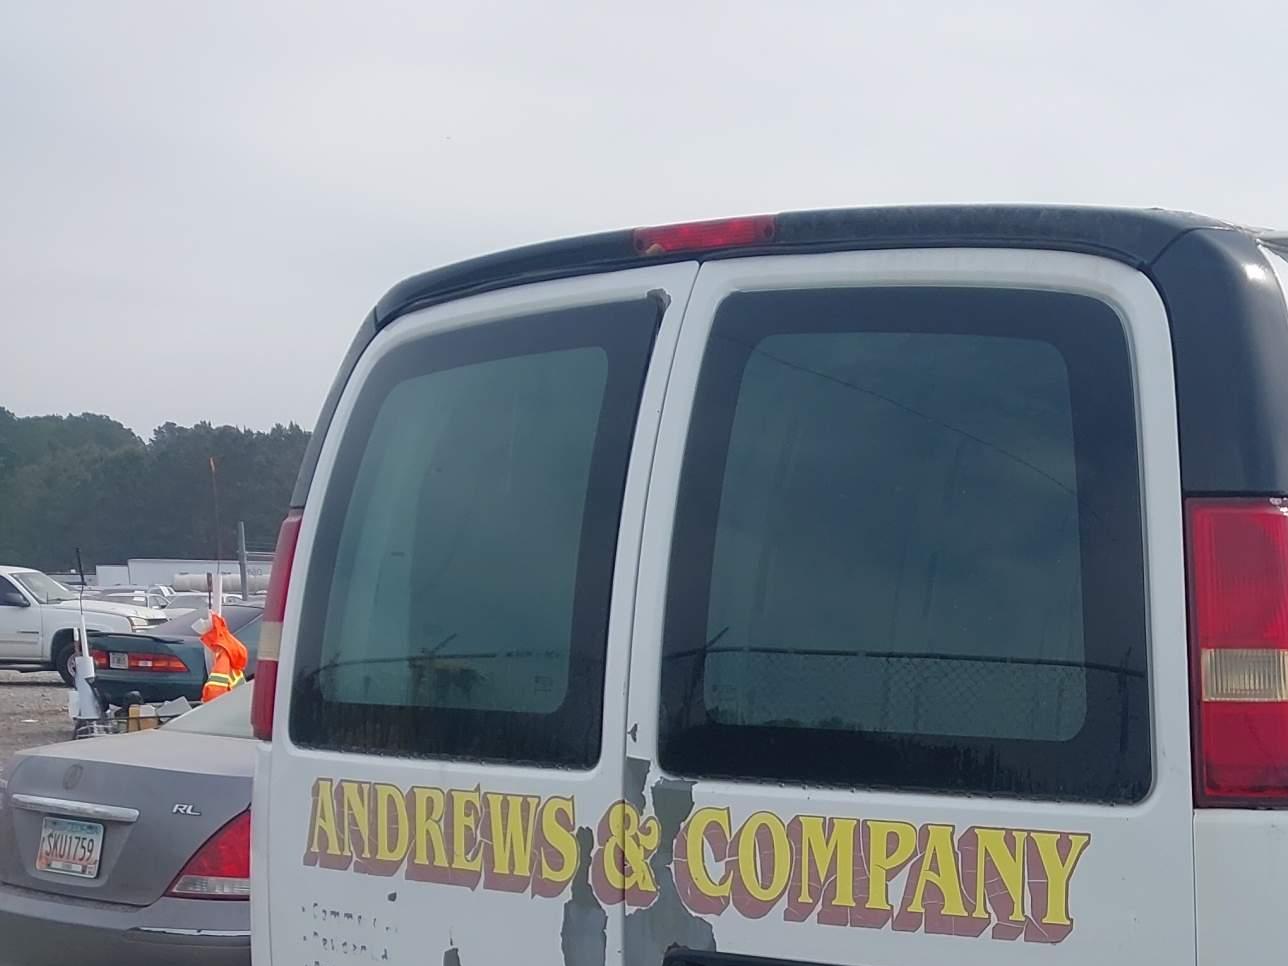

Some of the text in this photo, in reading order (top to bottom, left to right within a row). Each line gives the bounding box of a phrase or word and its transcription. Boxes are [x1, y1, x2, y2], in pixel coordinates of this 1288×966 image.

[172, 803, 201, 816] RL
[45, 832, 95, 863] SKU1759
[303, 777, 1092, 944] ANDREWS & COMPANY
